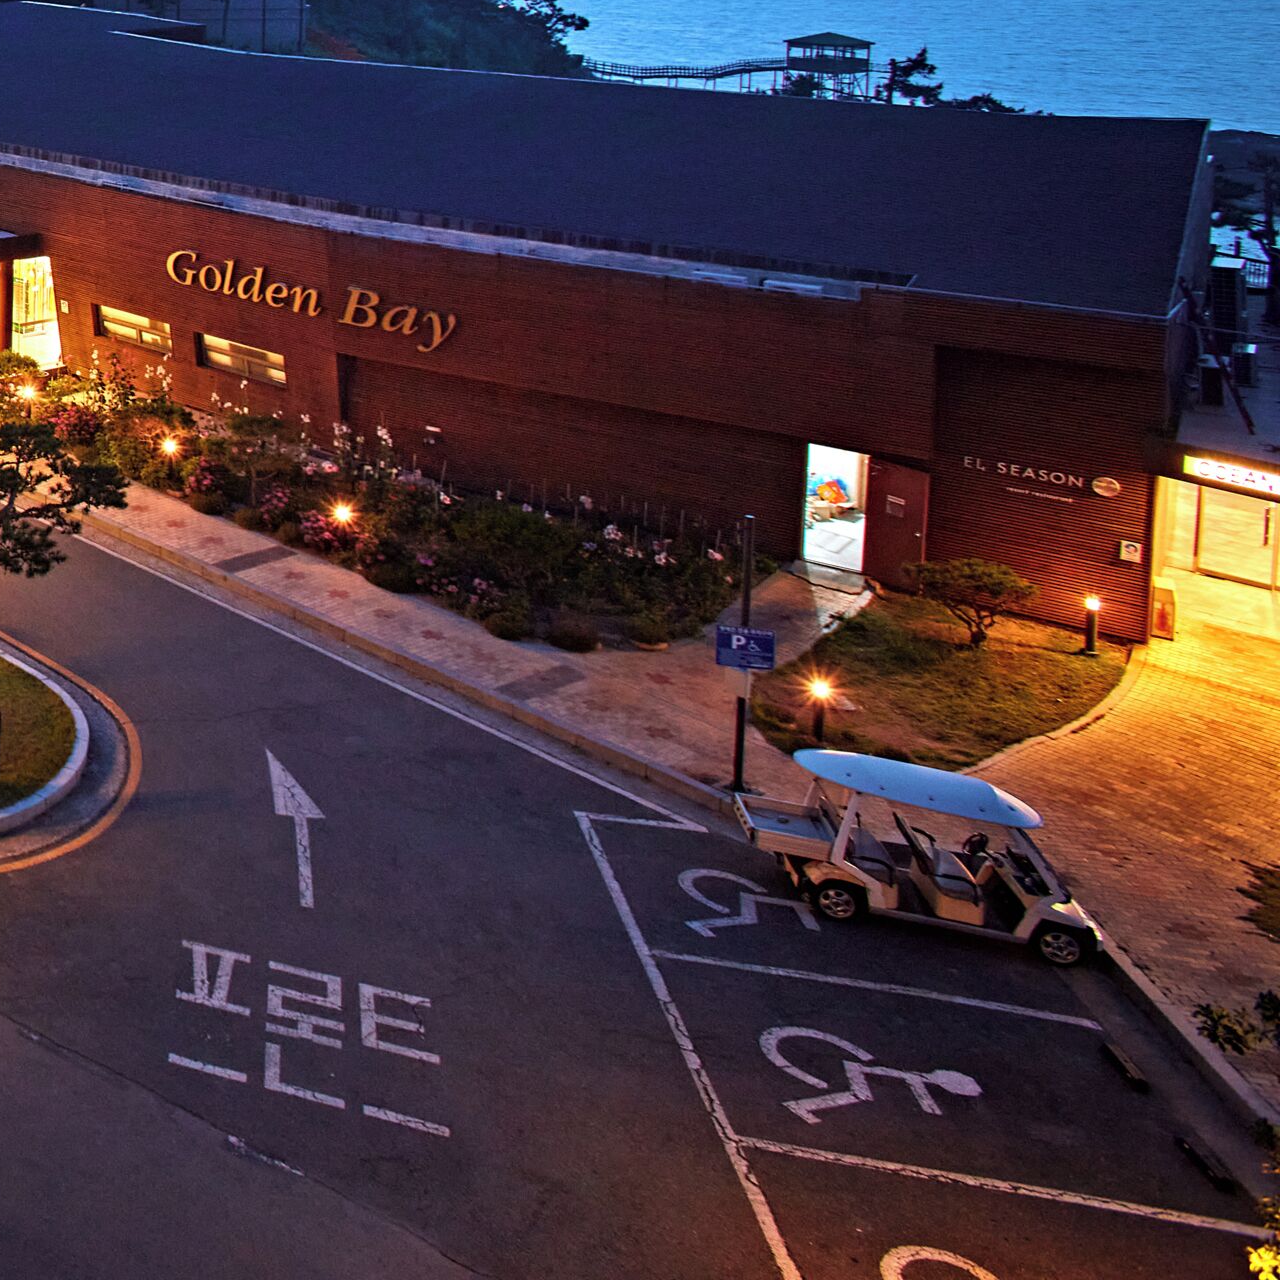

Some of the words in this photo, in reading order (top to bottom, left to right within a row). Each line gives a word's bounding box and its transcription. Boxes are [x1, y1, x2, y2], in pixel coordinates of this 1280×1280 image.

[166, 249, 322, 317] Golden
[338, 286, 456, 353] Bay
[963, 456, 986, 471] EL
[997, 462, 1084, 487] SEASON
[731, 635, 746, 649] P
[168, 939, 452, 1138] 프론트
